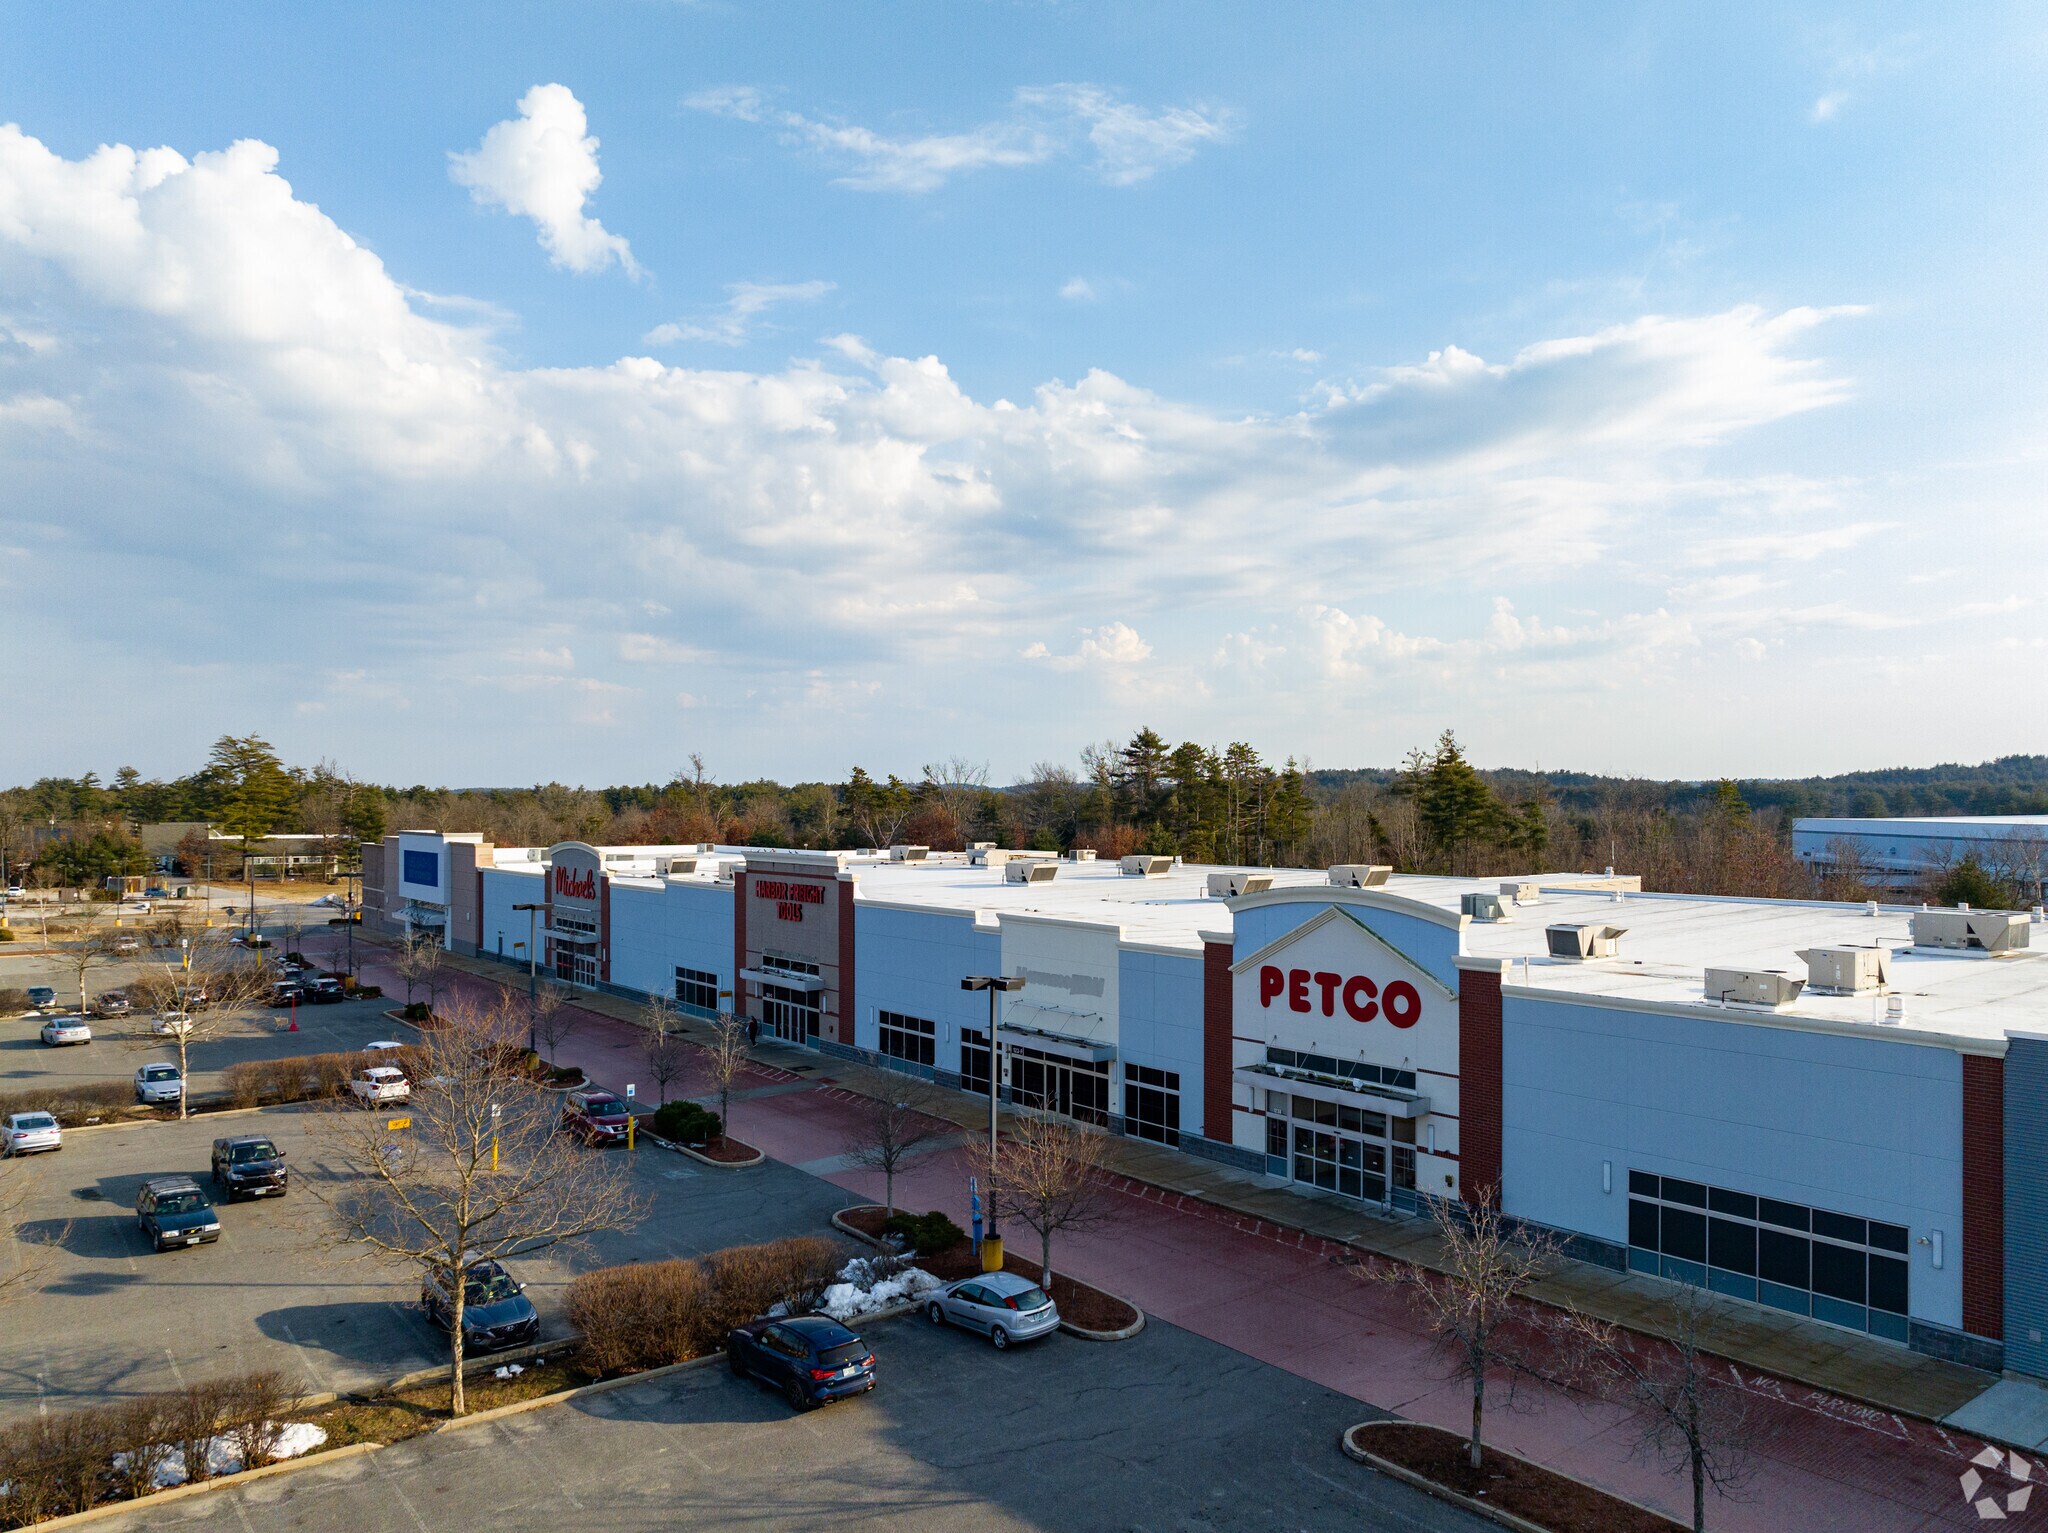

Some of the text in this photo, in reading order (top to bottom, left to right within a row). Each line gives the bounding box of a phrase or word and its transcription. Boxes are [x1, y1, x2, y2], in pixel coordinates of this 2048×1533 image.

[556, 866, 596, 900] Michaels
[756, 880, 825, 904] HARBOR FREIGHT
[776, 902, 802, 922] TOOLS
[1260, 965, 1421, 1028] PETCO
[1749, 1375, 1886, 1422] NO PARKING
